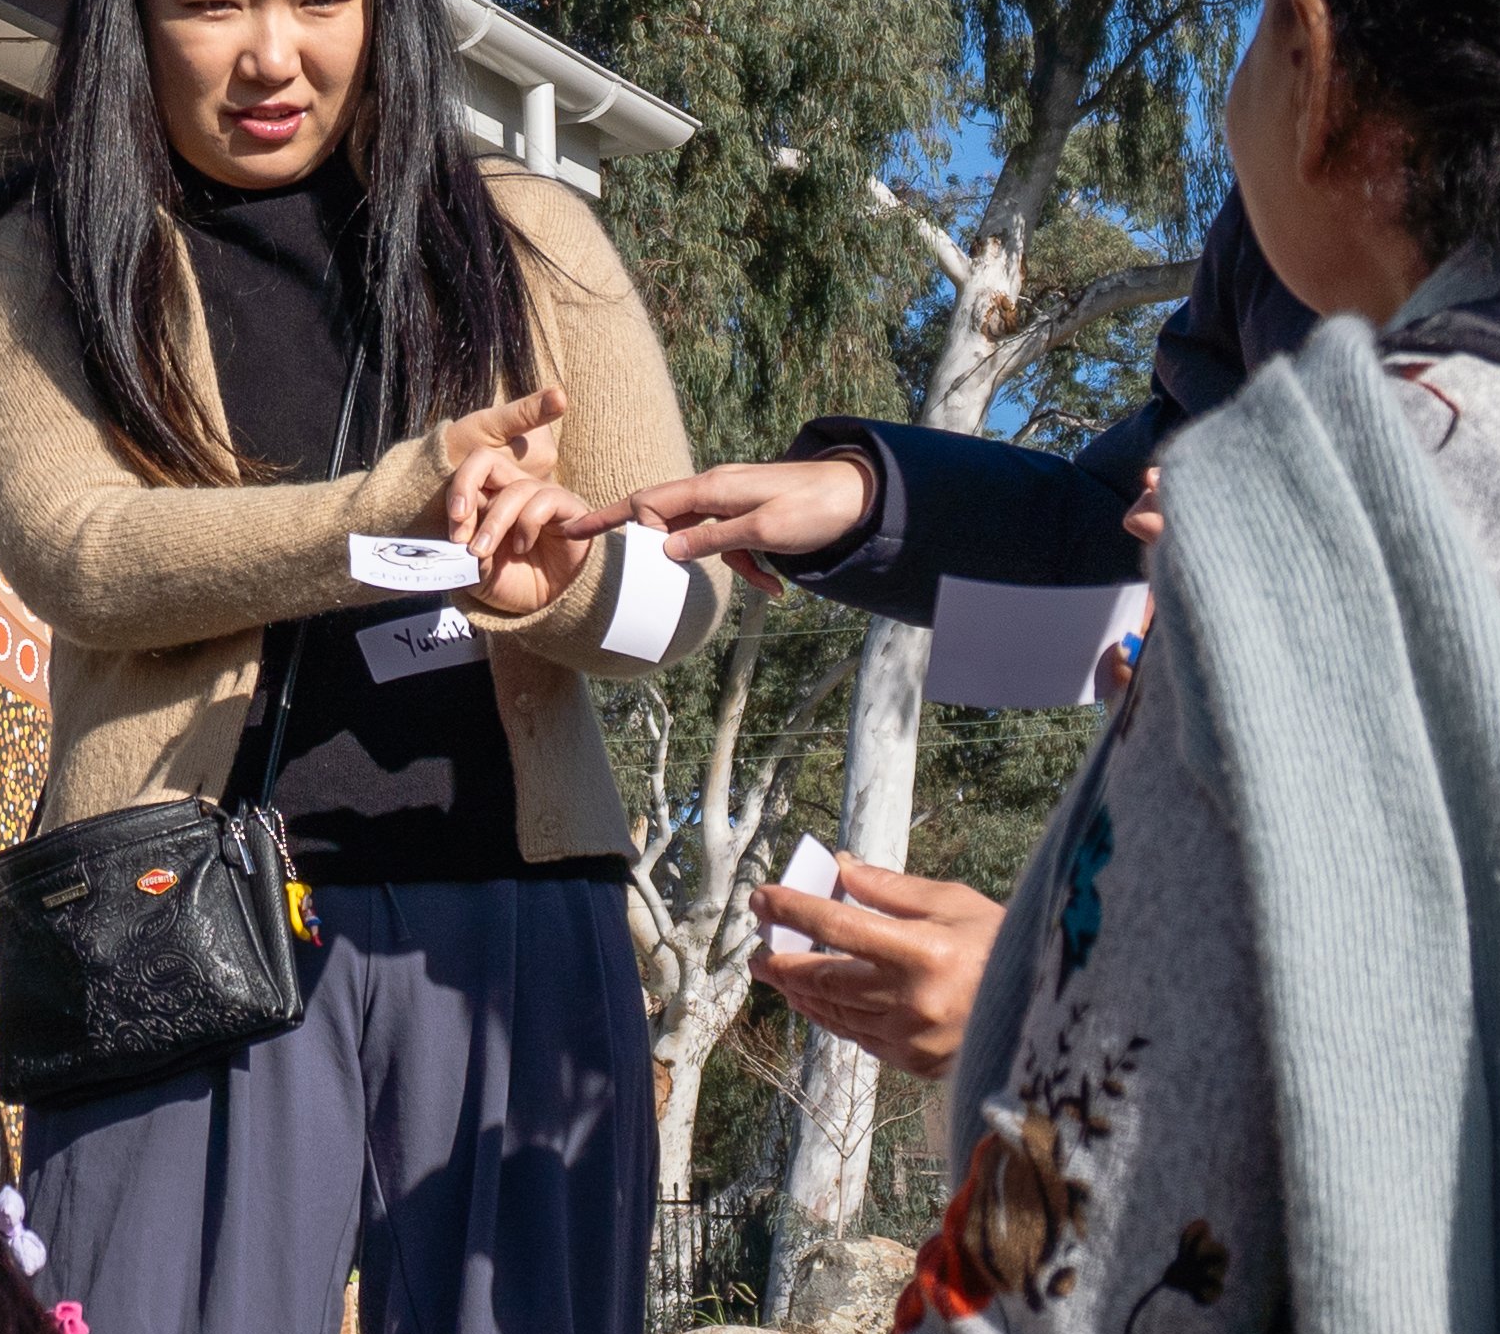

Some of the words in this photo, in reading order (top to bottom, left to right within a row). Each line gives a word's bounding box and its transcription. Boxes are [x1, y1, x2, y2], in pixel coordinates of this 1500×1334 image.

[369, 571, 467, 585] chirping
[393, 620, 478, 658] Yukiko
[140, 873, 175, 888] VEGEMITE
